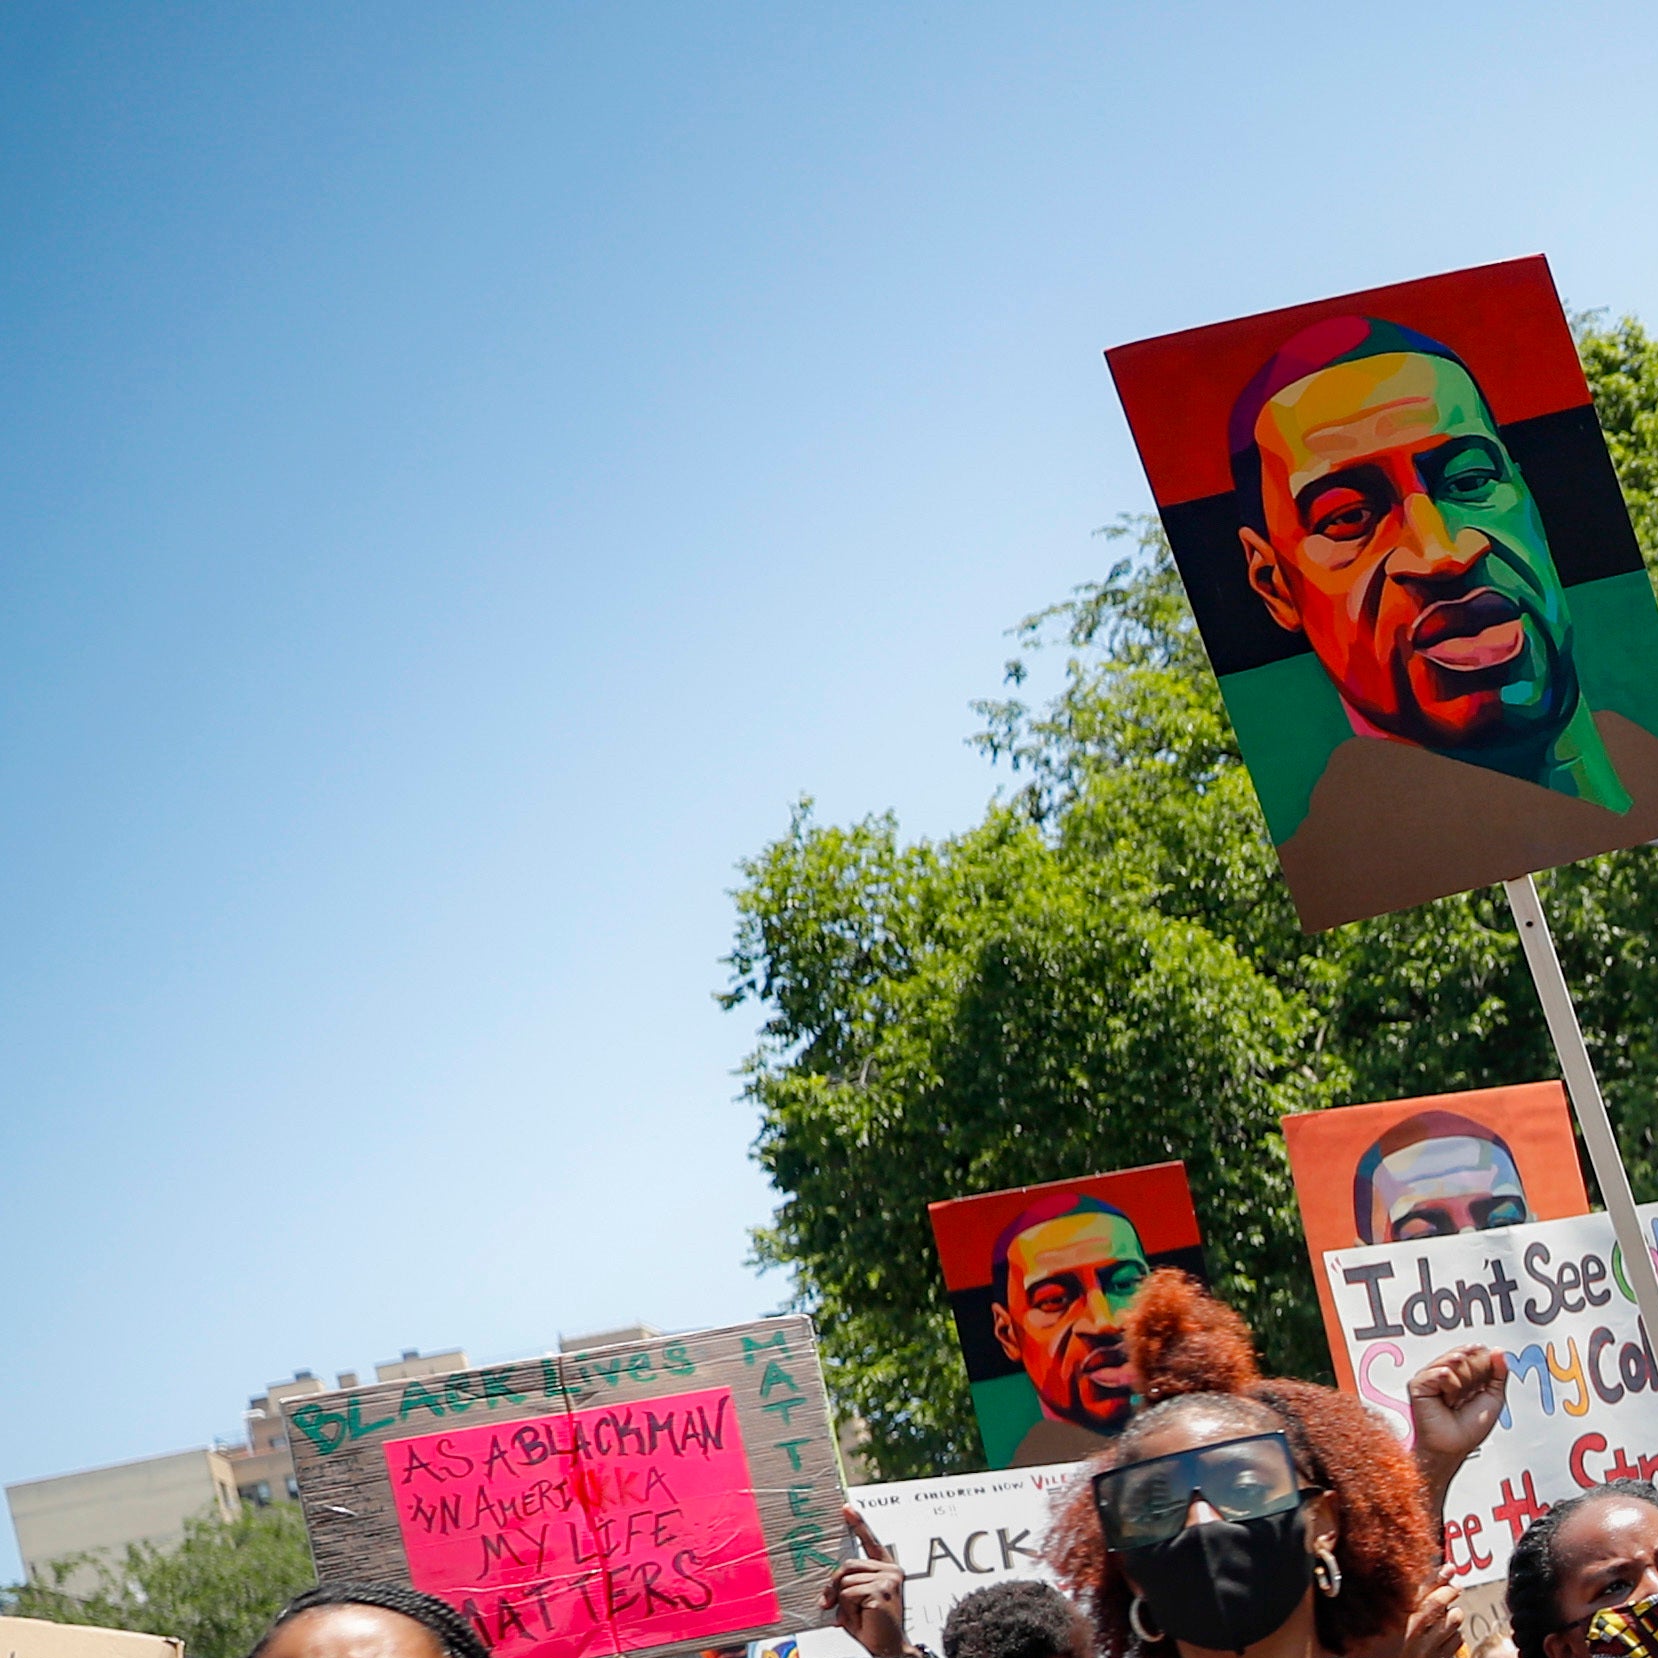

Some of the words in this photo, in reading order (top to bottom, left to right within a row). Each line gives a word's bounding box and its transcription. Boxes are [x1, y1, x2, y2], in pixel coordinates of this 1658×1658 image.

[1402, 1257, 1518, 1336] don't
[1523, 1241, 1612, 1326] See
[402, 1437, 475, 1486] AS
[740, 1330, 841, 1576] MATTER
[856, 1494, 901, 1509] YOUR
[914, 1486, 986, 1503] CHILDREN
[992, 1481, 1023, 1493] HOW
[1444, 1513, 1493, 1576] ee
[1492, 1469, 1553, 1546] th
[476, 1523, 548, 1581] MY
[566, 1508, 683, 1566] LIFE
[884, 1527, 1040, 1581] LACK
